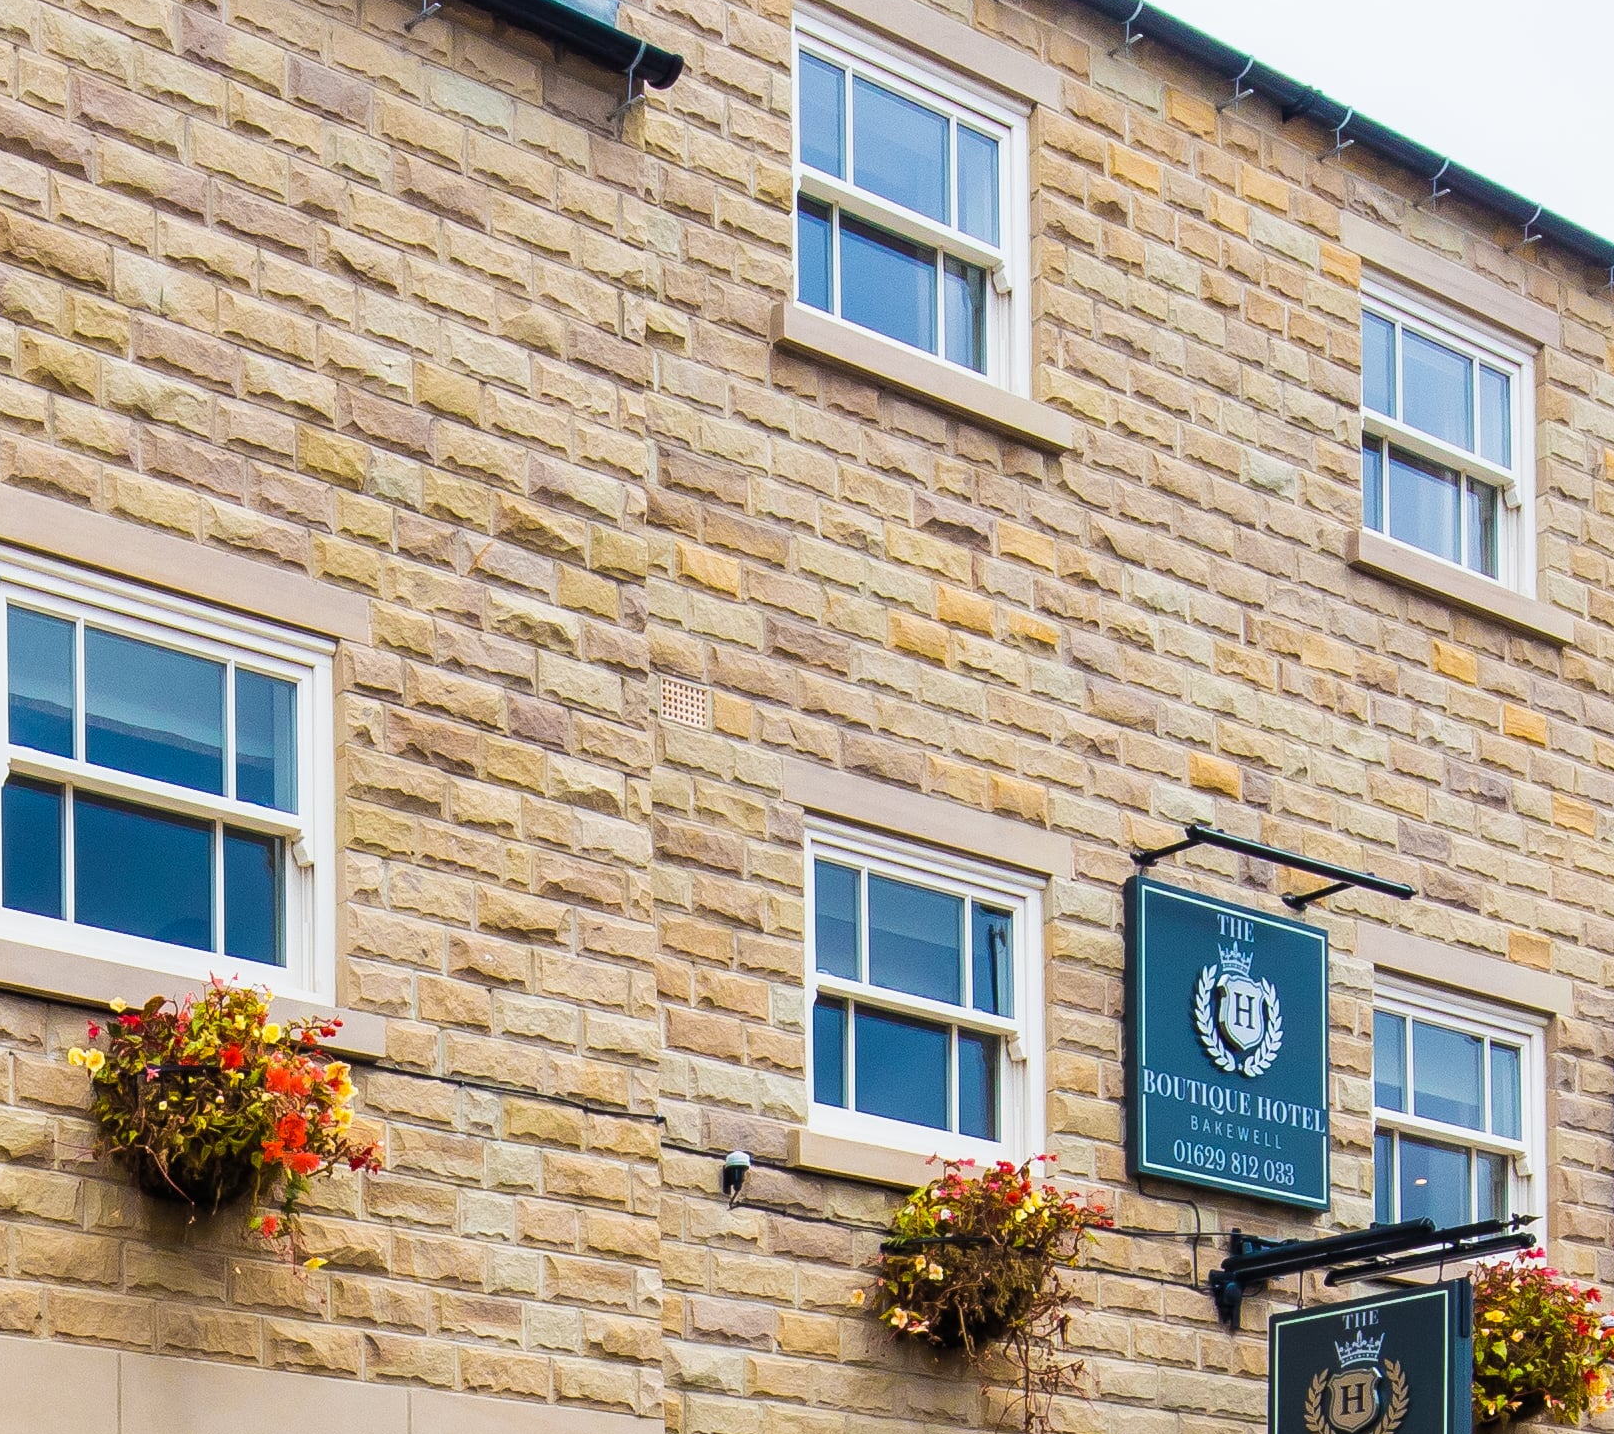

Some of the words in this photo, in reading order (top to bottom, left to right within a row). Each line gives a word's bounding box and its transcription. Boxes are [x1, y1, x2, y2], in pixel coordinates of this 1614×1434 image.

[1217, 914, 1254, 943] THE
[1233, 993, 1255, 1030] H
[1143, 1069, 1251, 1115] BOUTIQUE
[1257, 1096, 1326, 1133] HOTEL
[1190, 1115, 1282, 1150] BAKEWELL
[1174, 1139, 1226, 1171] 01629
[1231, 1152, 1259, 1179] 812
[1264, 1159, 1295, 1186] 033
[1342, 1310, 1379, 1330] THE
[1340, 1382, 1366, 1416] H
